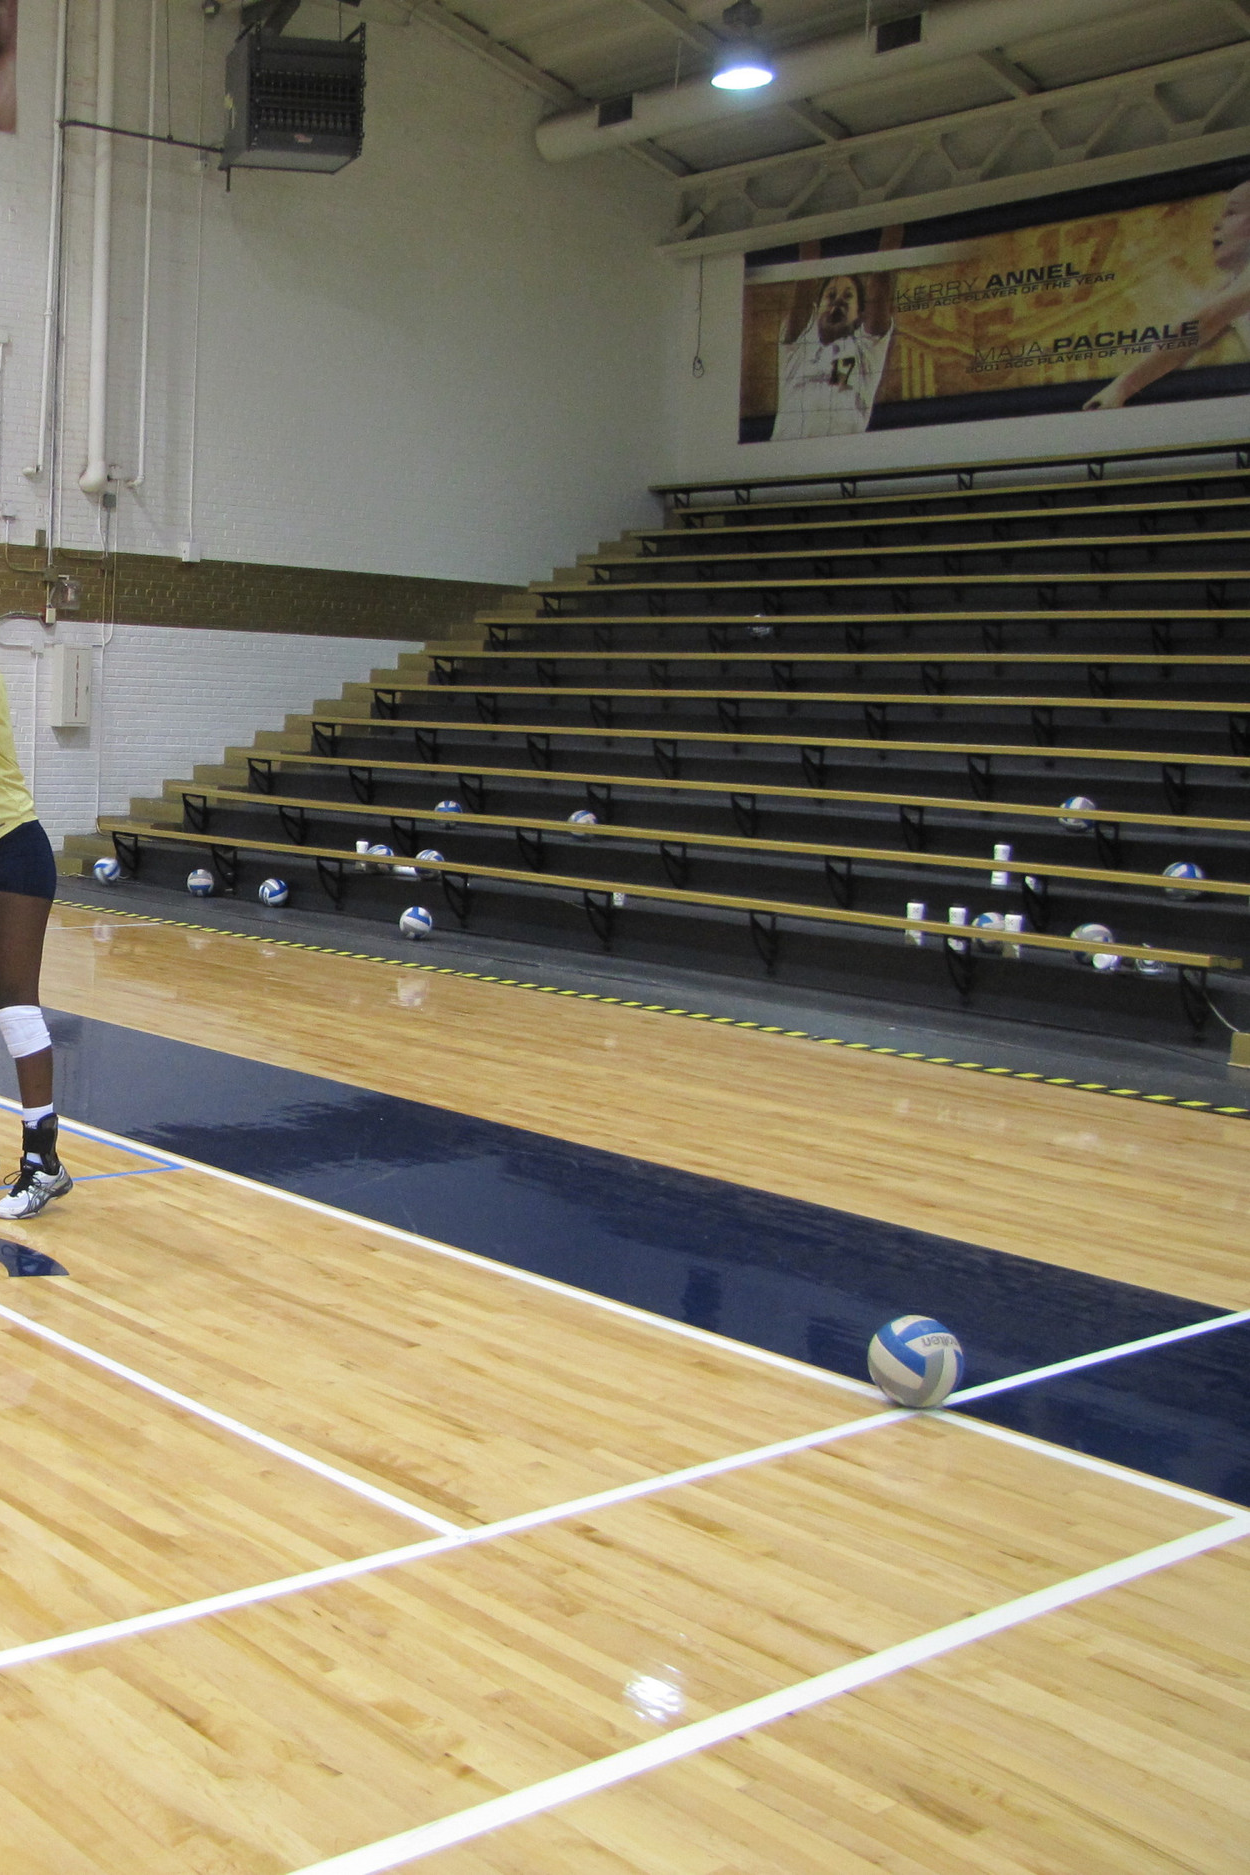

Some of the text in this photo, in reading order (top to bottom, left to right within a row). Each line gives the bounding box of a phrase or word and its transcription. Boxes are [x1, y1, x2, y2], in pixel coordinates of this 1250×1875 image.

[896, 262, 1081, 304] KERRY ANNEL
[933, 296, 962, 307] ACC
[966, 287, 1018, 301] PLAYER
[1021, 285, 1039, 295] OF
[1044, 279, 1071, 290] THE
[1076, 272, 1116, 286] YEAR
[974, 320, 1200, 363] MAJA PACHALE
[1003, 359, 1034, 369] ACC
[1037, 352, 1093, 365] PLAYER
[1097, 350, 1118, 359] OF
[1123, 344, 1152, 355] THE
[1156, 338, 1200, 351] YEAR
[830, 356, 856, 385] 17
